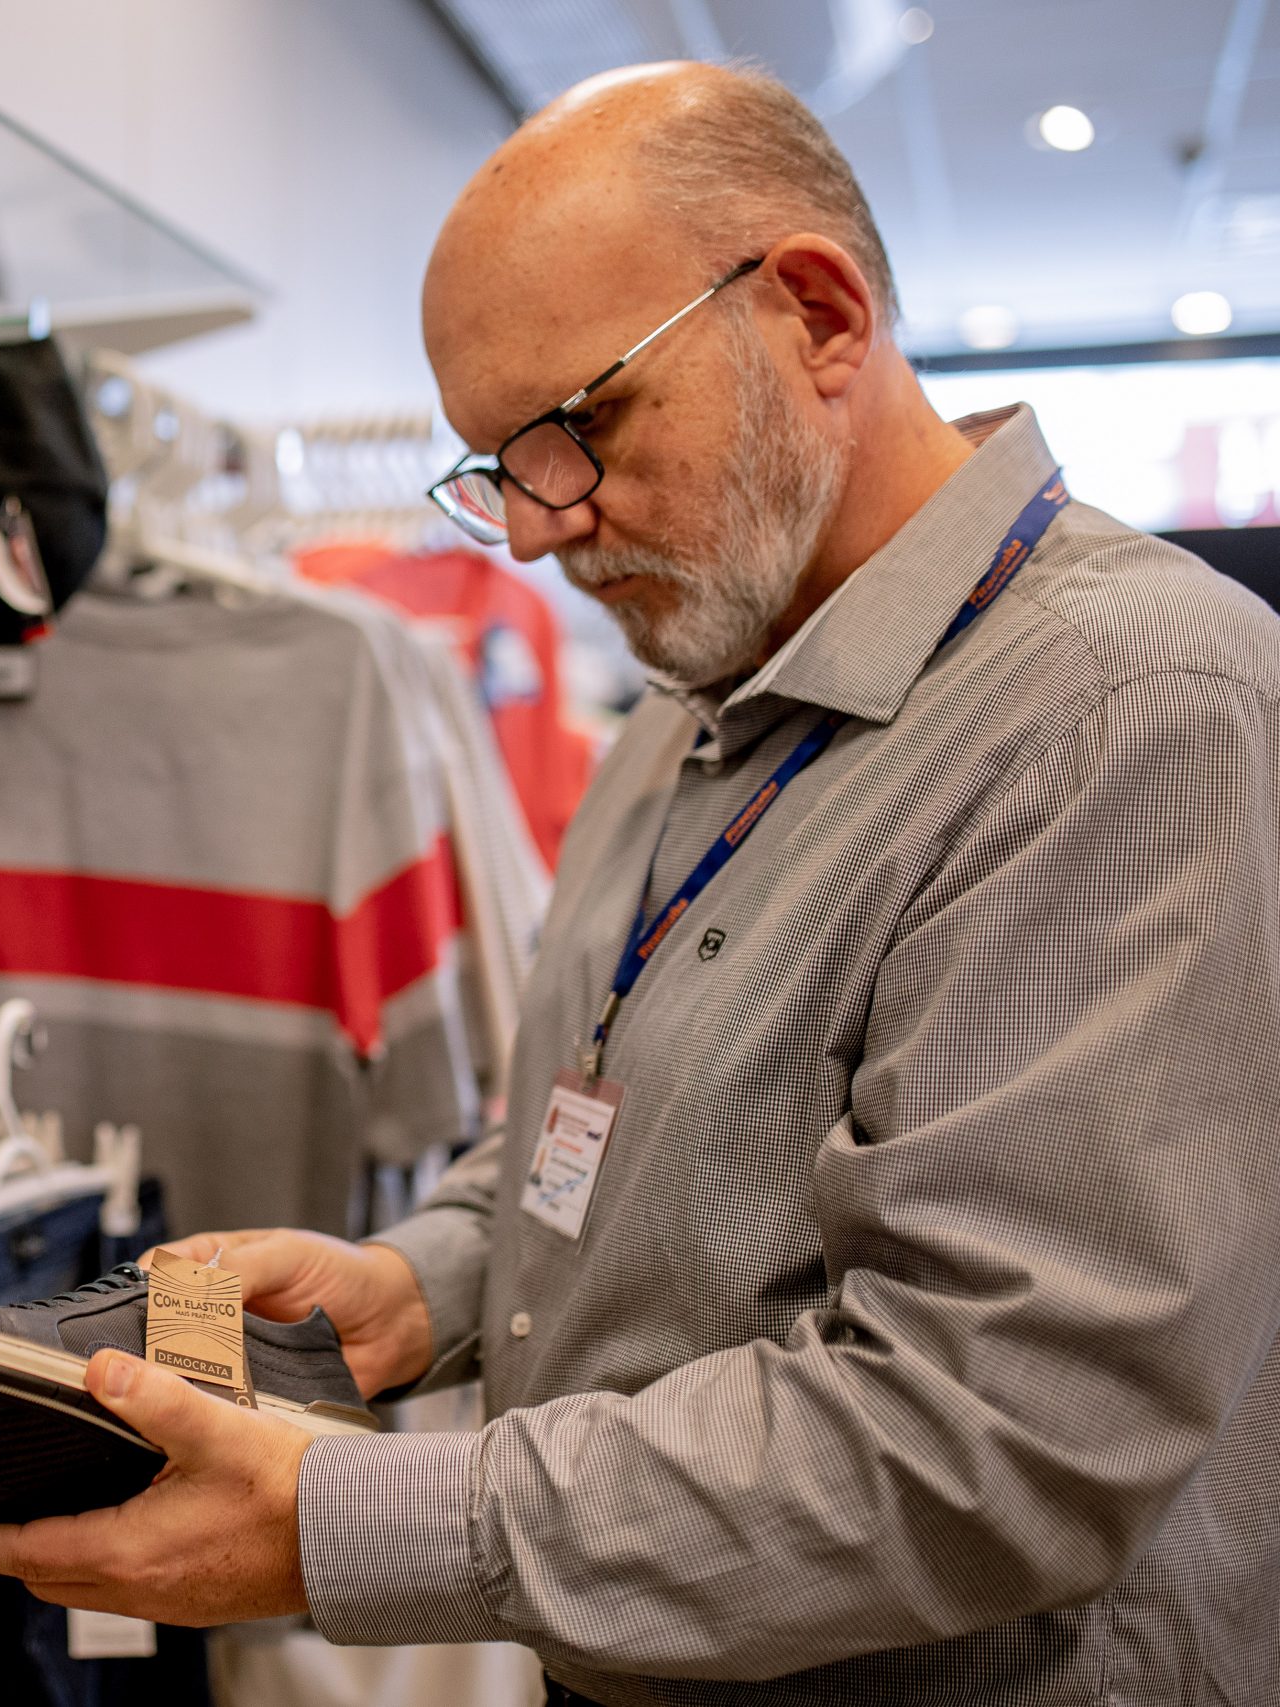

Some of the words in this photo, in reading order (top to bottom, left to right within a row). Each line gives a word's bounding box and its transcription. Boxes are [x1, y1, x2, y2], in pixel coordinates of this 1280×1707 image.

[153, 1292, 181, 1308] COM
[175, 1310, 190, 1318] MAIS
[158, 1351, 229, 1377] DEMOCRATA
